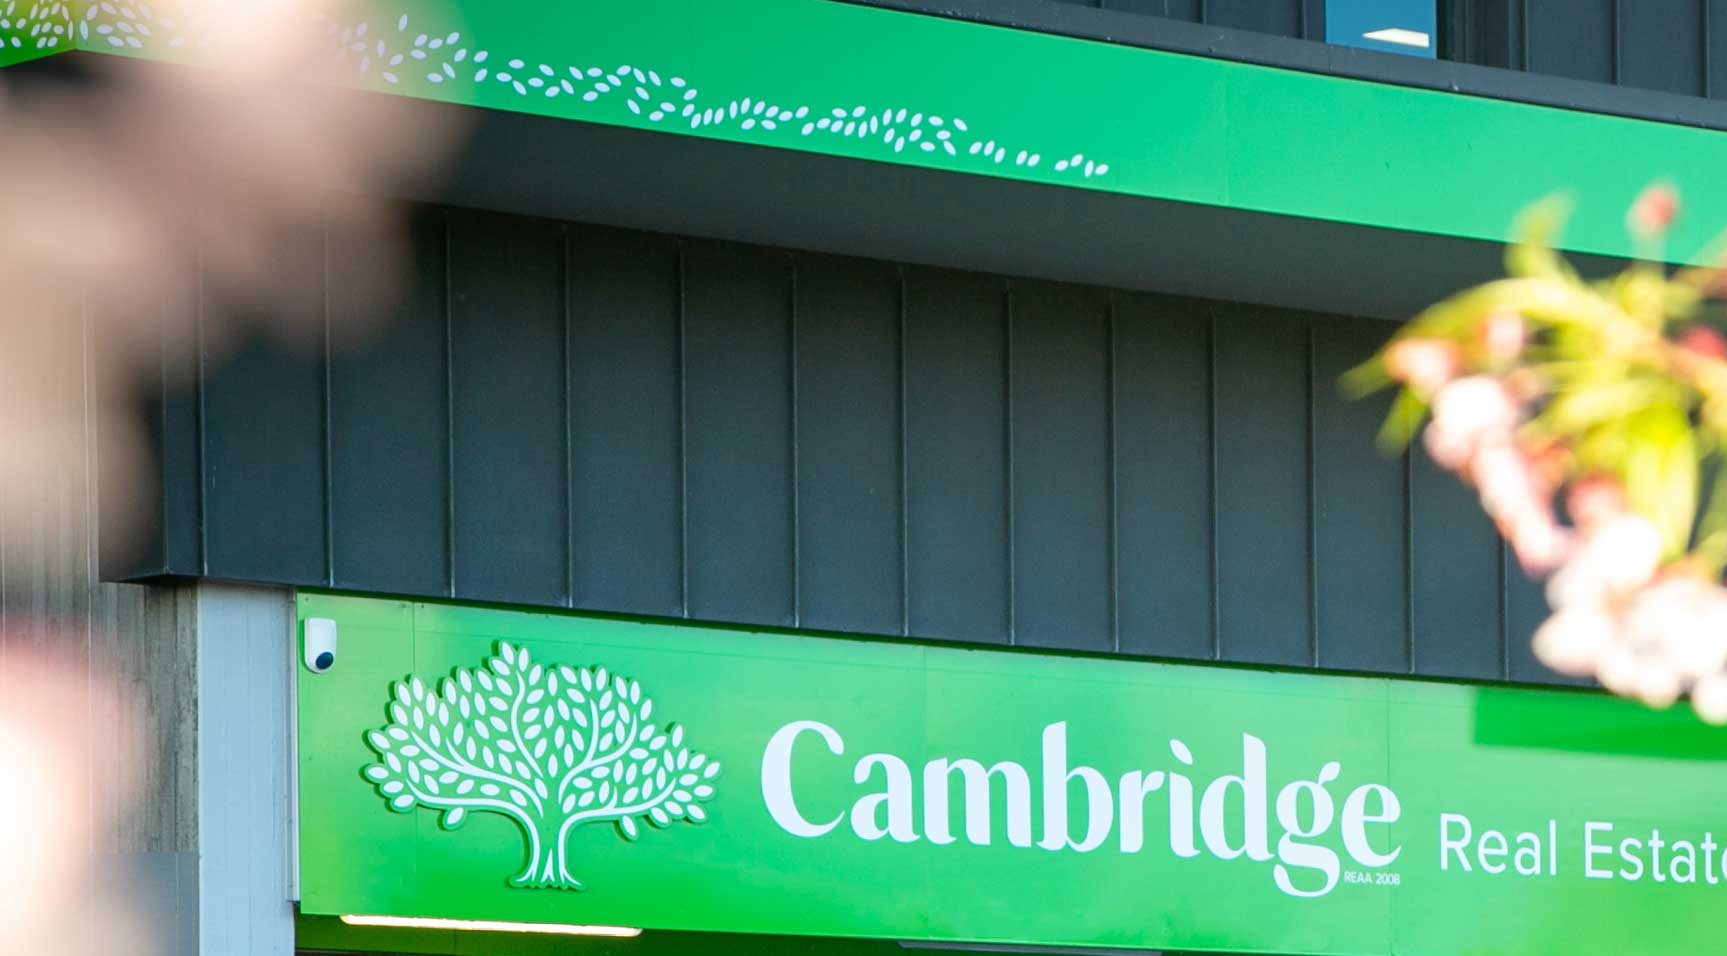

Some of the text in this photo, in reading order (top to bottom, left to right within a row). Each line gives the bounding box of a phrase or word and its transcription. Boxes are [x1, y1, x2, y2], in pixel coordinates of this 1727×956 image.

[760, 719, 1402, 898] Cambridge
[1439, 812, 1557, 877] Real
[1343, 870, 1374, 884] REAA
